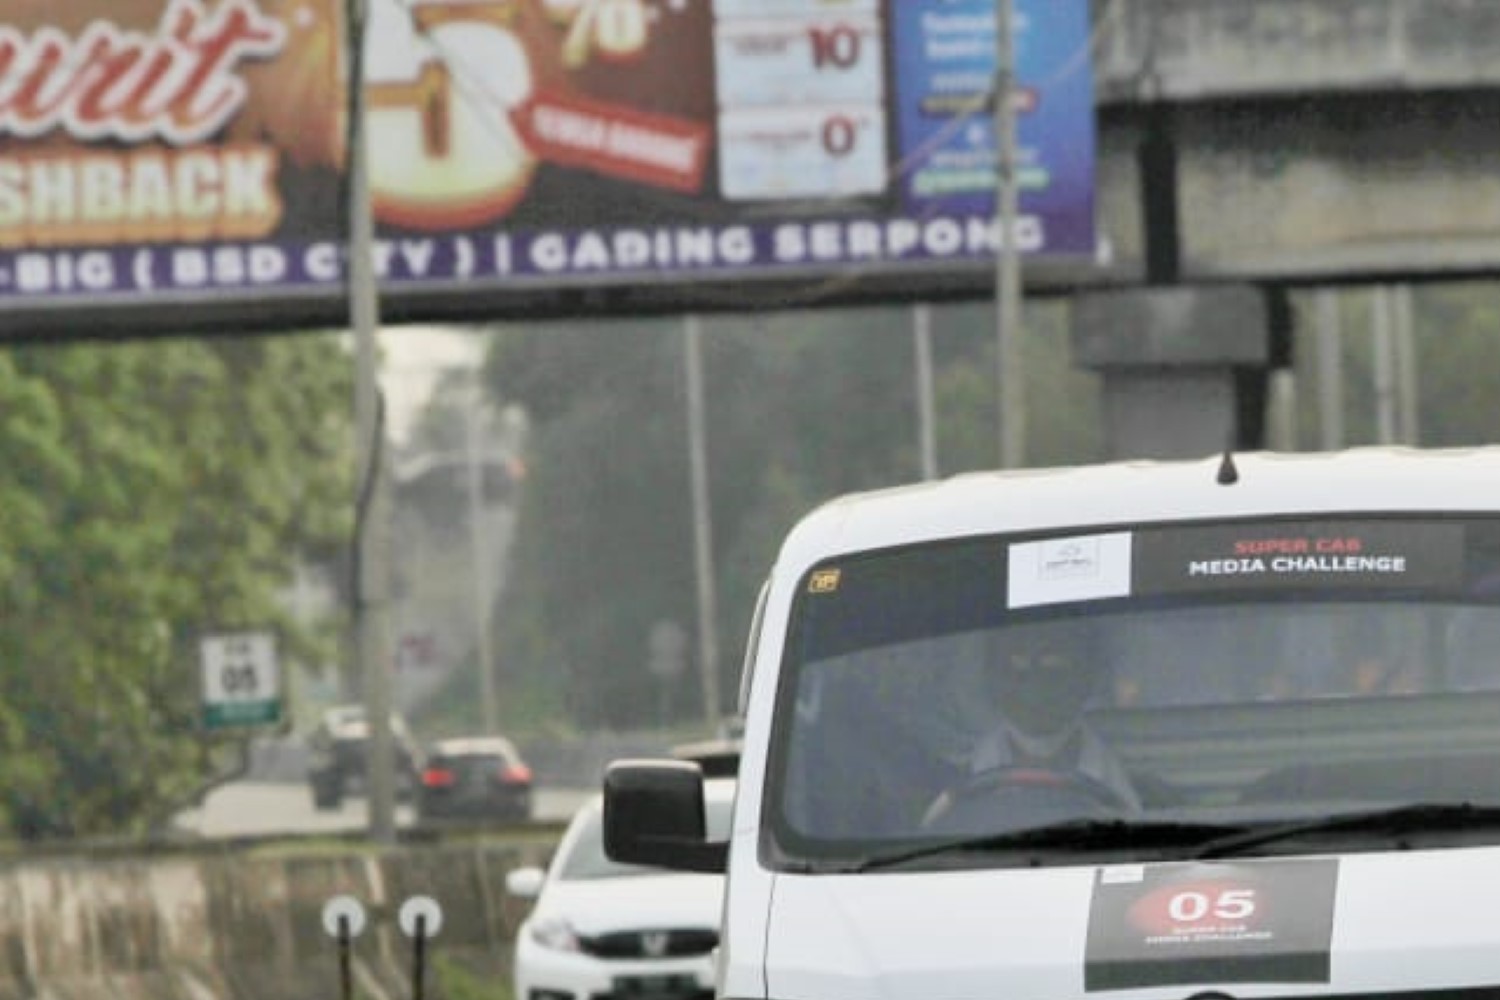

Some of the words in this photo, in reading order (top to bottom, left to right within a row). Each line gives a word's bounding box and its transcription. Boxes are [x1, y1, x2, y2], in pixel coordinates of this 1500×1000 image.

[172, 244, 286, 285] BSD
[304, 236, 434, 282] CTY
[529, 223, 753, 272] GADING
[774, 213, 1044, 263] SERPONG
[1234, 538, 1308, 554] SUPER
[1189, 560, 1265, 576] MEDIA
[1271, 555, 1407, 573] CHALLENGE
[1168, 889, 1256, 921] 05
